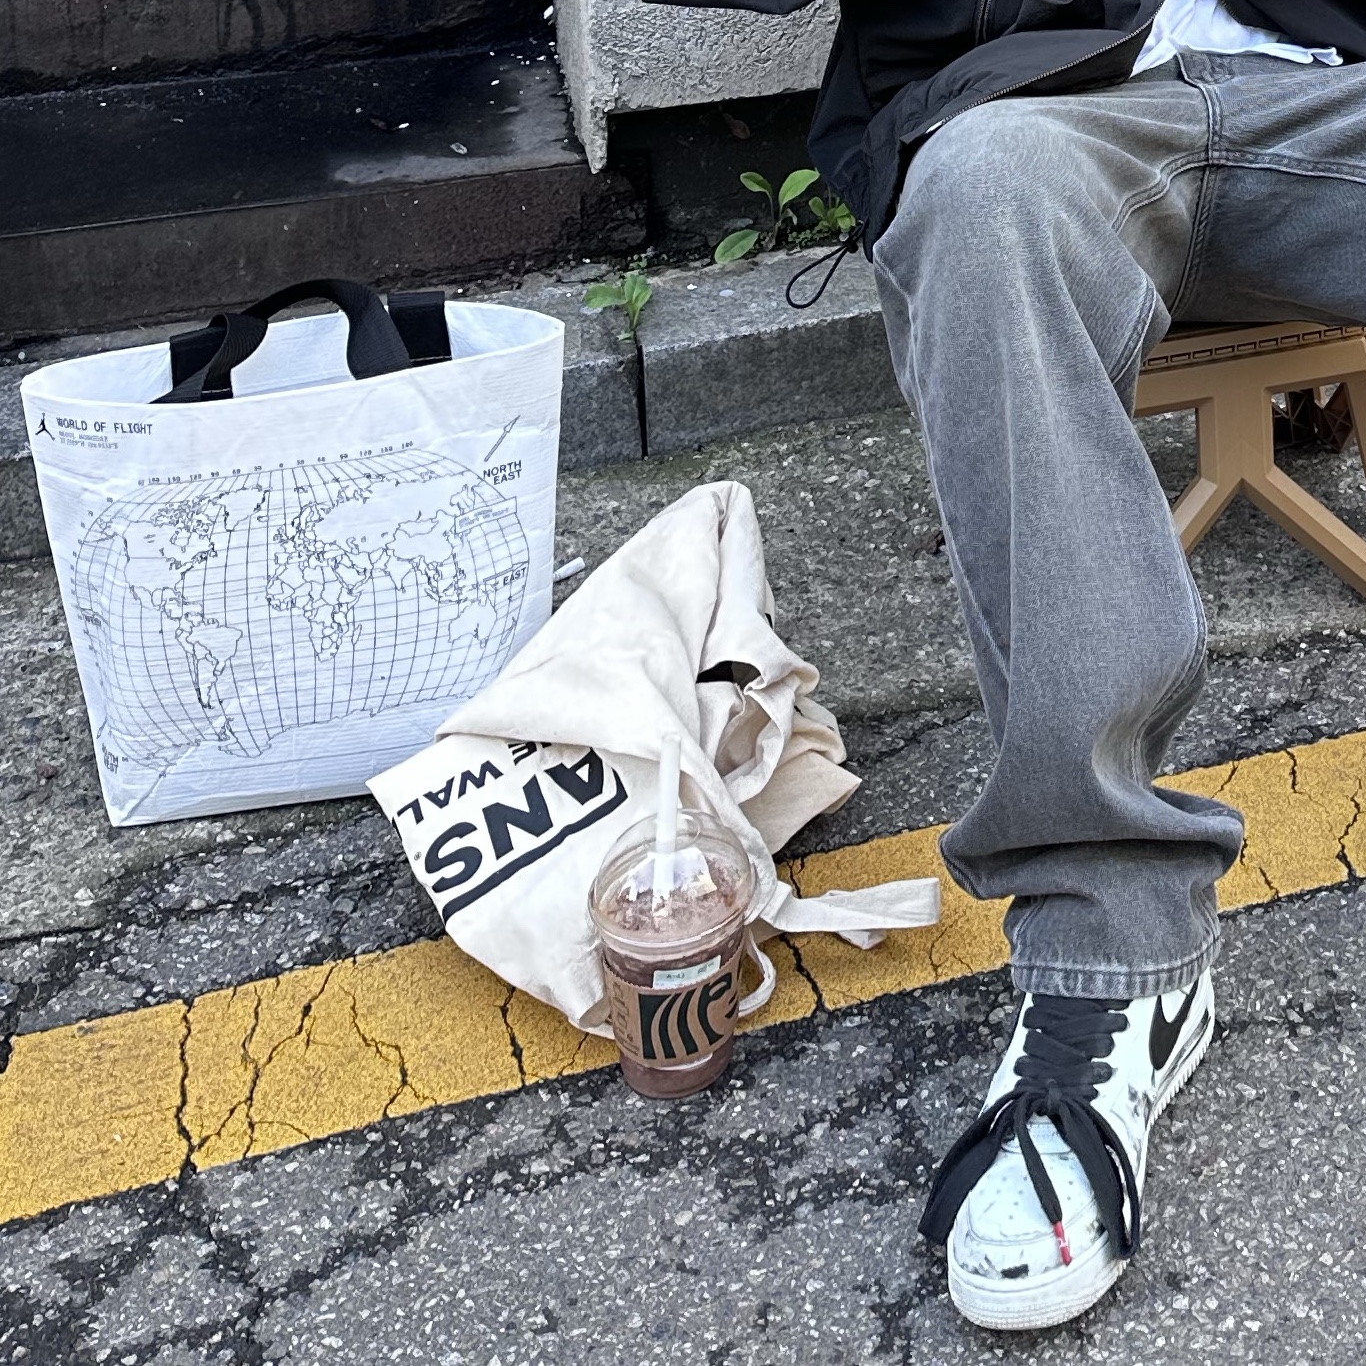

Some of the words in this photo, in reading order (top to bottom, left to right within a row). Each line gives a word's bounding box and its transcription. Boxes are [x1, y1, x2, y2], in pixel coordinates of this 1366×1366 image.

[56, 417, 88, 432] WORLD
[93, 421, 107, 433] OF
[113, 422, 153, 436] FLIGHT
[483, 460, 522, 479] NORTH
[493, 470, 522, 485] EAST
[502, 567, 527, 586] EAST
[392, 760, 504, 840] WAL
